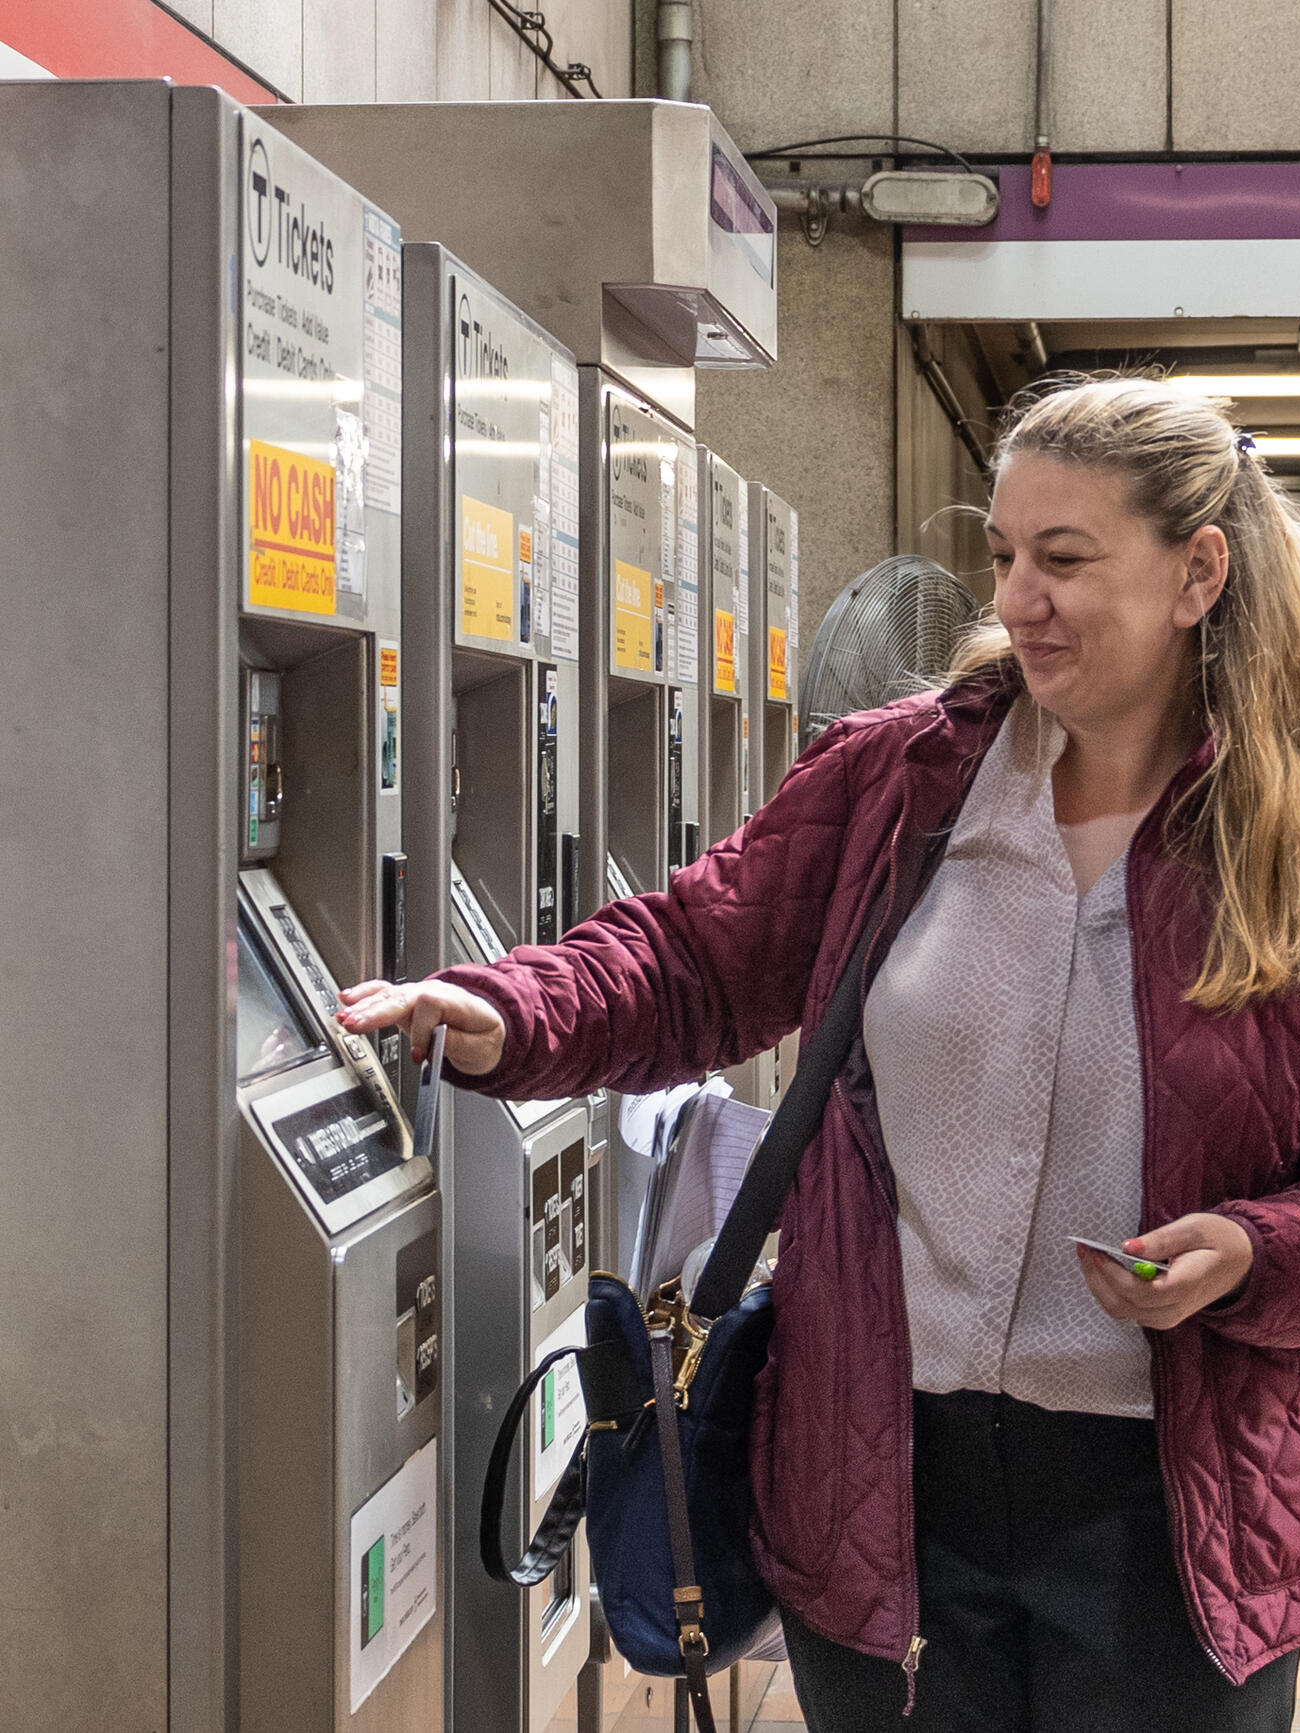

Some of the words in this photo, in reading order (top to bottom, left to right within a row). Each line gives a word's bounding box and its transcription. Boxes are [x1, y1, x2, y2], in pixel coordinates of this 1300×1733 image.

[274, 185, 333, 295] Tickets
[247, 322, 271, 364] Credit
[255, 454, 282, 535] NO
[287, 464, 335, 546] CASH
